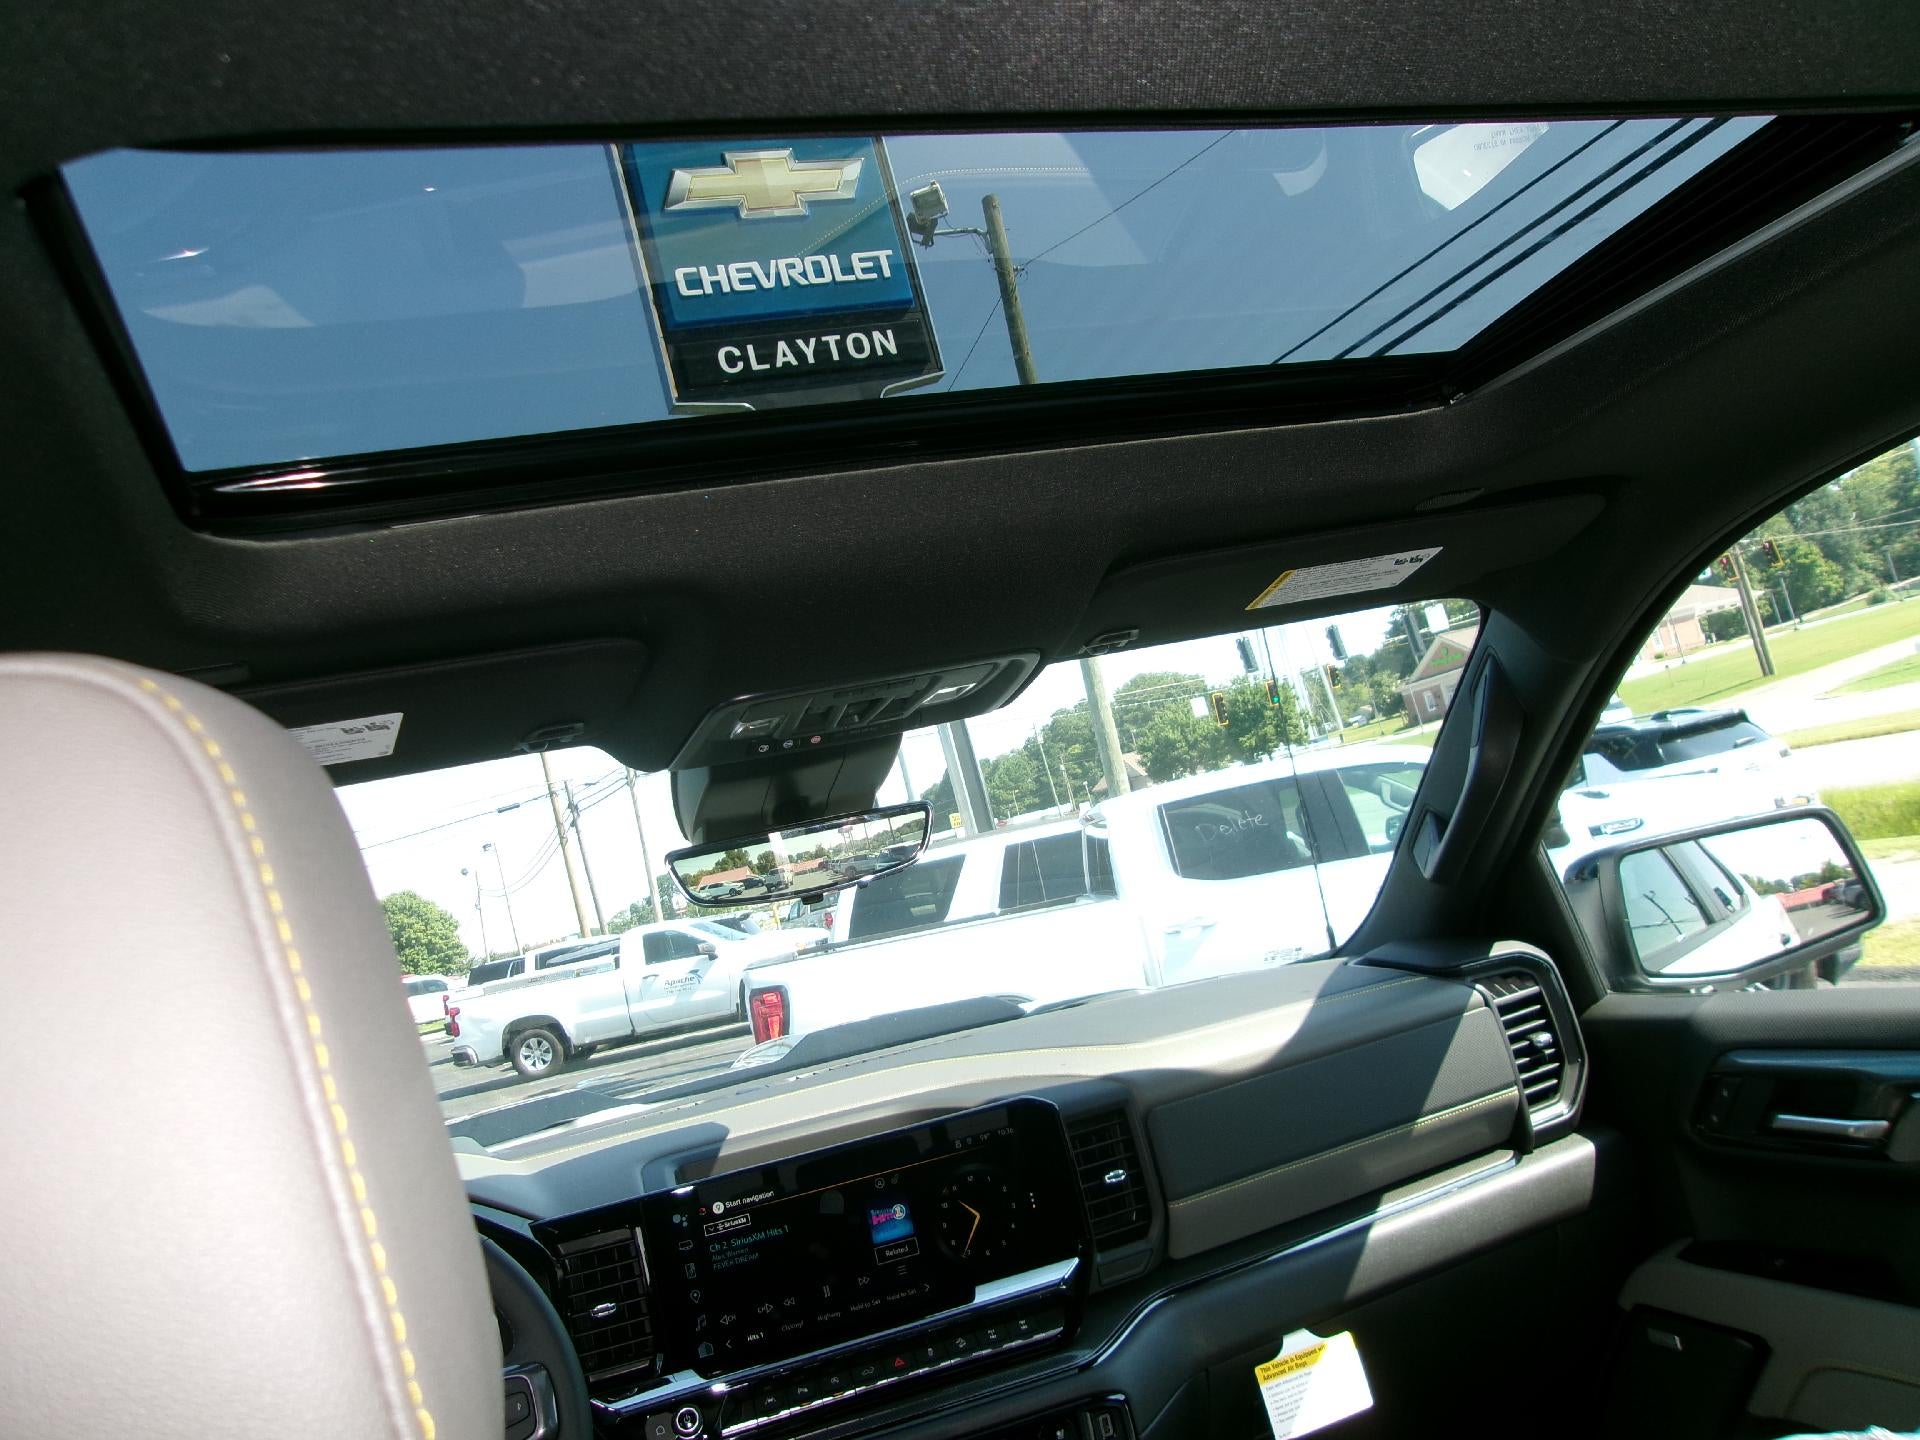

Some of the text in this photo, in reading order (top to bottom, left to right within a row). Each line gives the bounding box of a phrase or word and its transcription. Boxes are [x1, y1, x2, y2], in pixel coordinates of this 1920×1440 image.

[674, 249, 893, 297] CHEVROLET
[717, 329, 898, 374] CLAYTON
[1195, 810, 1268, 842] Delete
[664, 975, 695, 986] Apache
[725, 1190, 775, 1208] Start navigation
[709, 1224, 789, 1253] Ch 2 SiriusXM Hits 1
[885, 1243, 909, 1257] Related
[1260, 1365, 1272, 1374] This
[1271, 1358, 1290, 1370] Vehicle
[1294, 1348, 1318, 1361] Equipped
[1263, 1369, 1287, 1381] Advanced
[1287, 1365, 1295, 1373] Air
